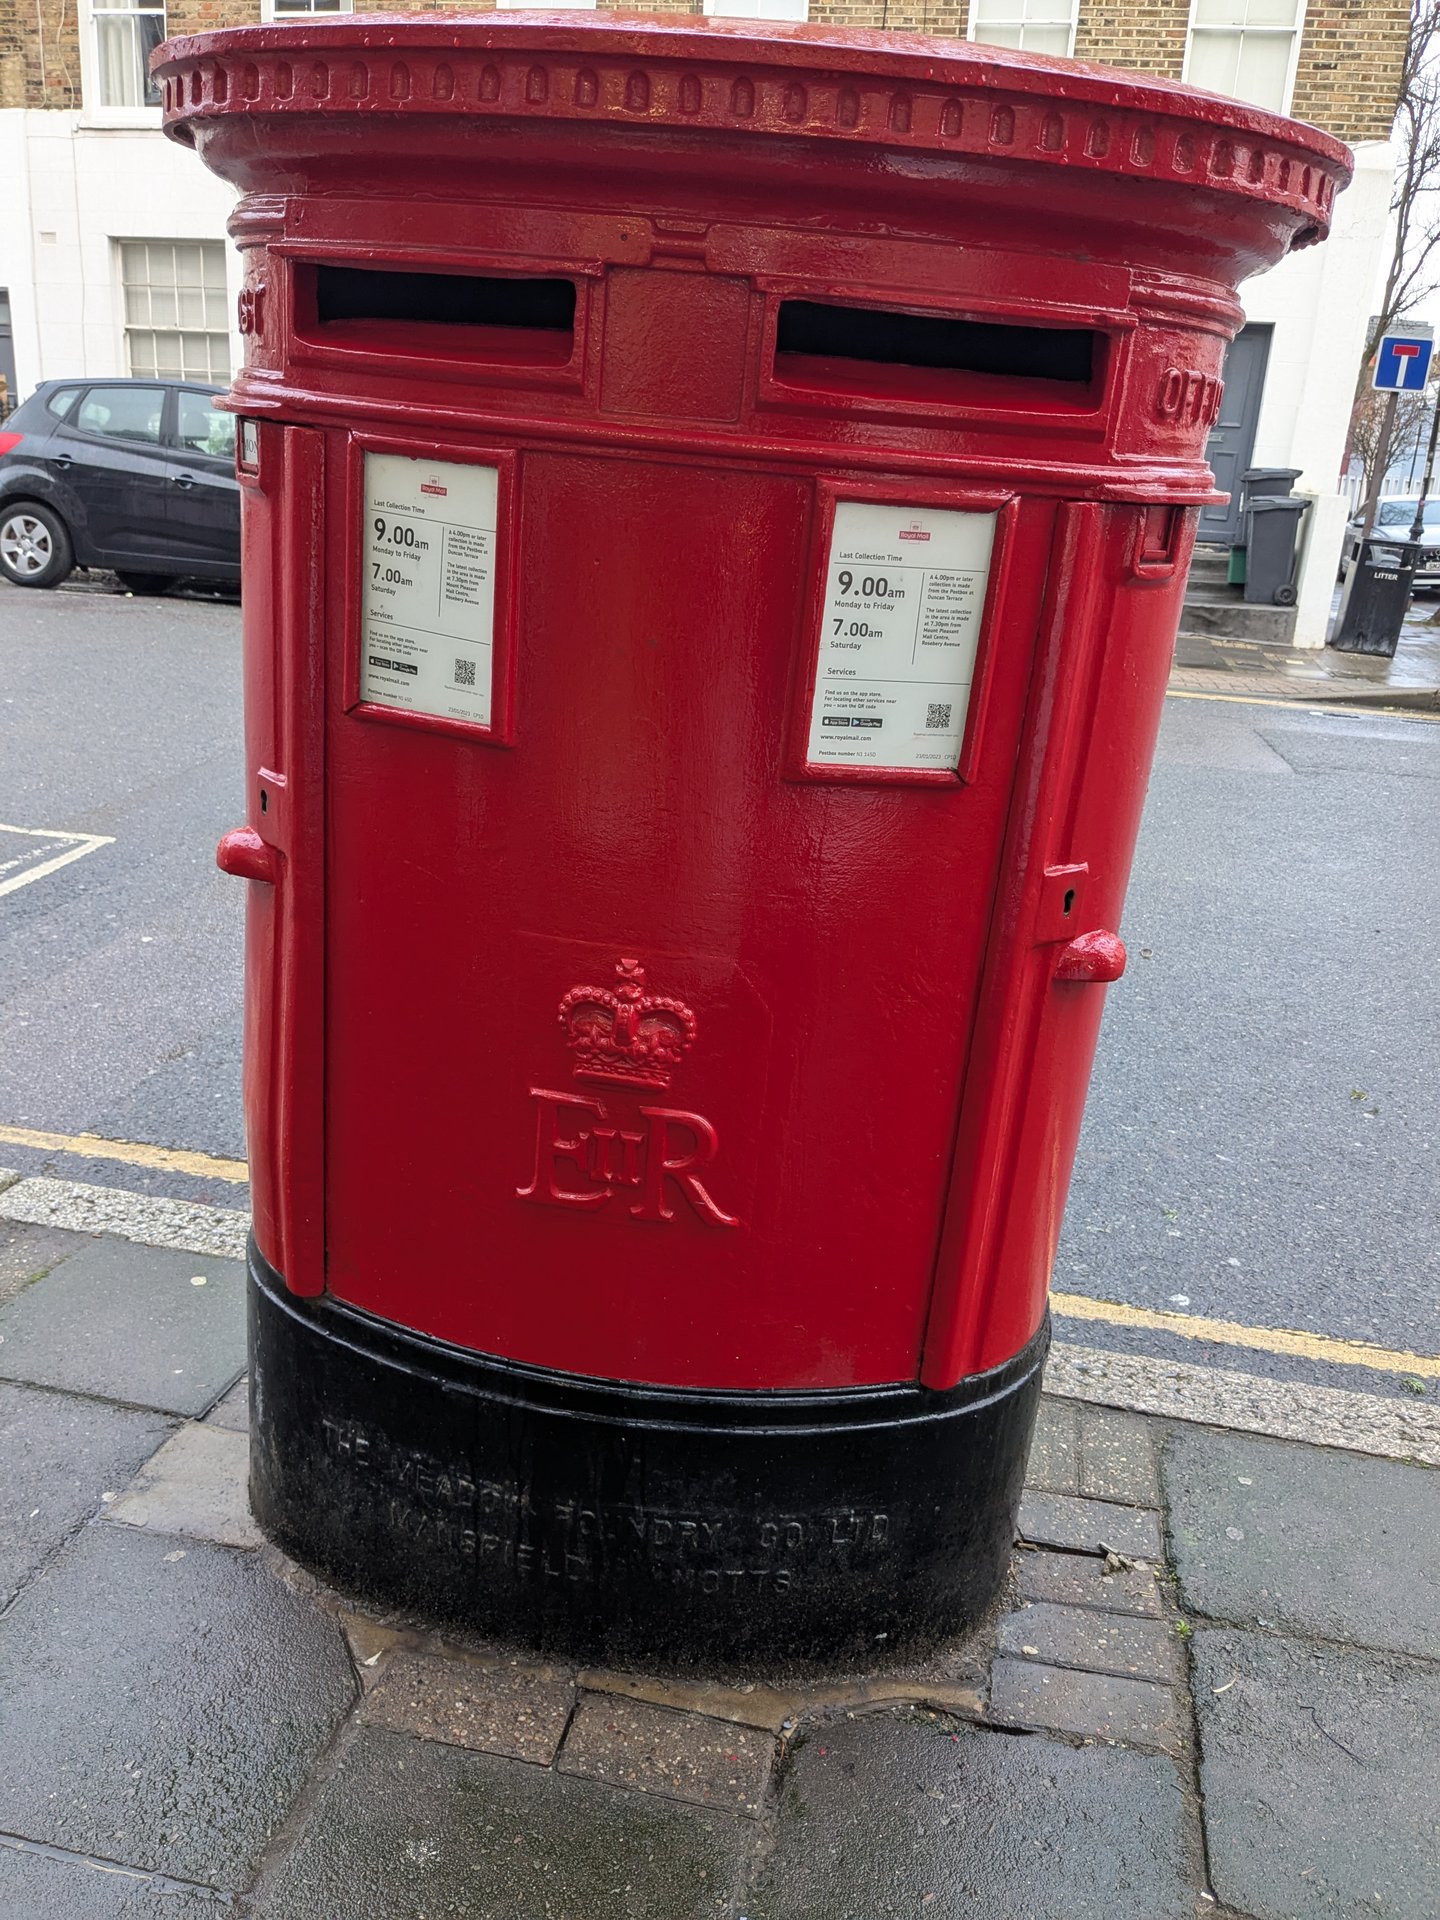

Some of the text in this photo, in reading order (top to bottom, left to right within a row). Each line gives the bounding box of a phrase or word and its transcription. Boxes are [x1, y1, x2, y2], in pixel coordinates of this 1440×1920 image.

[374, 499, 425, 514] Last Collection Time
[374, 517, 429, 550] 9.00am
[452, 530, 470, 538] 4.00pm
[372, 545, 394, 556] Monday
[403, 551, 421, 561] Friday
[839, 551, 903, 562] Last Collection Time
[372, 562, 413, 586] 7.00am
[468, 566, 487, 574] collection
[452, 576, 468, 584] 7.30pm
[1374, 571, 1398, 581] LITTER
[460, 584, 477, 592] Pleasant
[838, 570, 905, 598] 9.00am
[371, 584, 396, 596] Saturday
[446, 594, 464, 603] Rosebery
[834, 600, 861, 609] Monday
[873, 602, 894, 611] Friday
[370, 609, 393, 620] Services
[833, 618, 883, 637] 7.00am
[376, 638, 391, 646] locating
[830, 641, 861, 650] Saturday
[827, 667, 856, 675] Services
[368, 674, 410, 686] www.royalmail.com
[322, 1418, 369, 1466] THE
[832, 1511, 889, 1544] LTD
